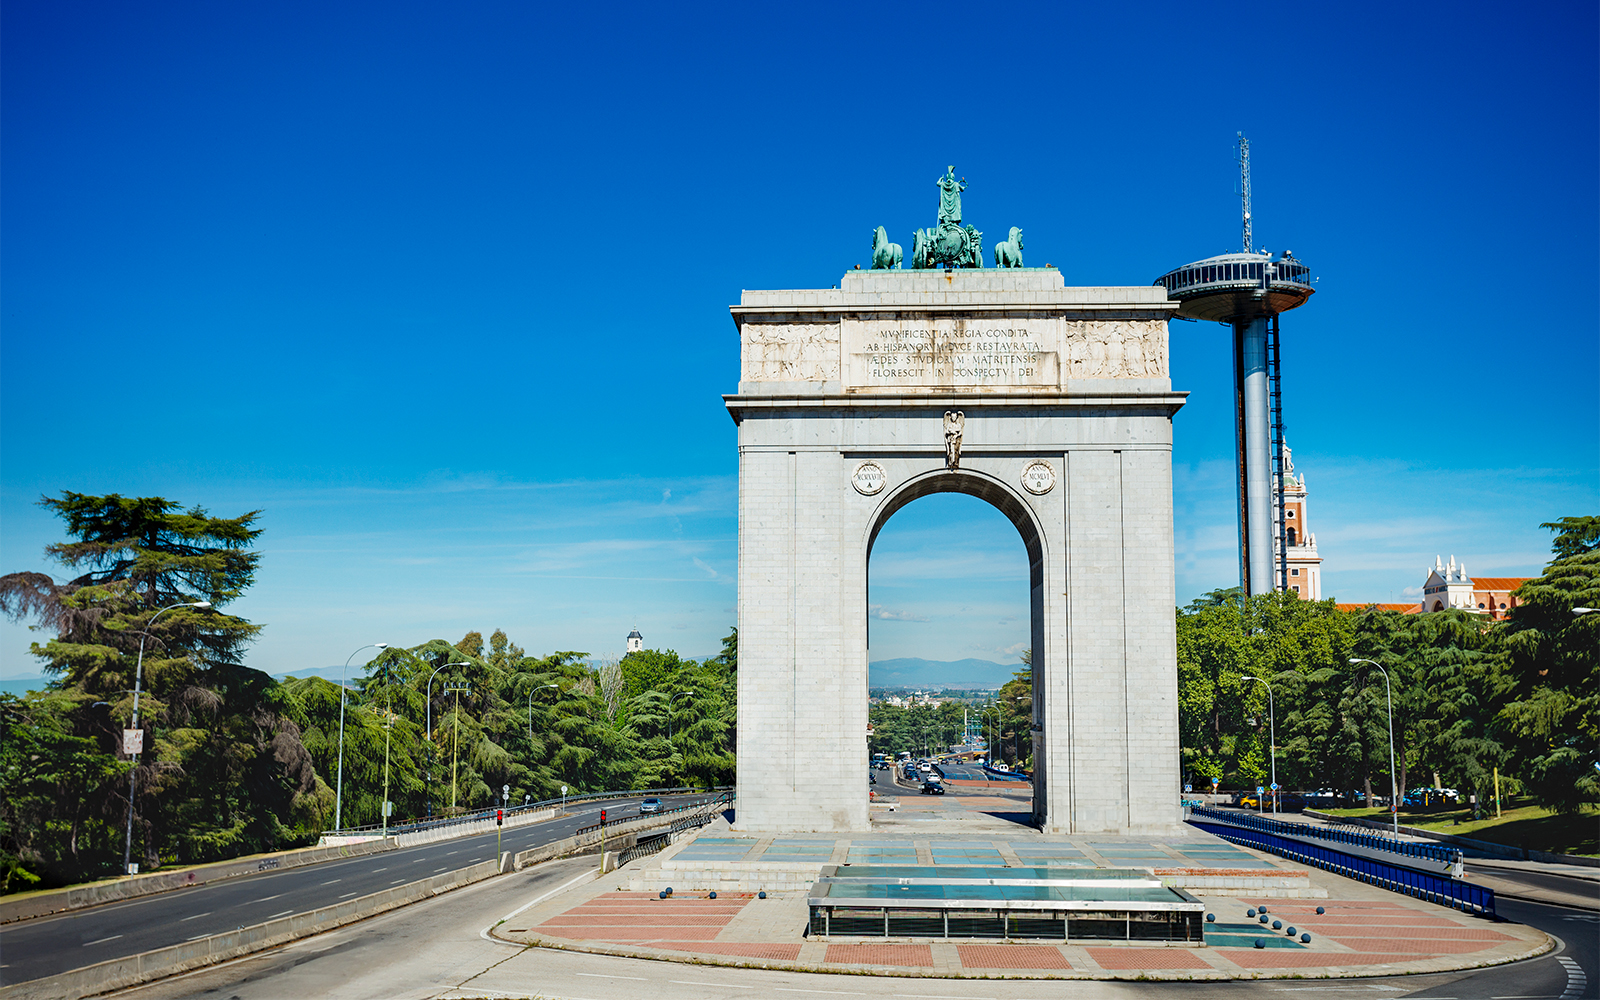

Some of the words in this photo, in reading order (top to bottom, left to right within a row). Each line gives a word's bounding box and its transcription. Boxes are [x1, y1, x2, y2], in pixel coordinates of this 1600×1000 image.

[953, 329, 982, 338] REGIA
[986, 328, 1029, 338] CONDITA
[866, 342, 880, 352] AB
[883, 342, 944, 352] HISPANORVM
[948, 342, 972, 351] DVCE
[976, 341, 1040, 351] RESTAVRATA
[906, 355, 964, 365] STVDIORVM
[972, 354, 1037, 364] MATRITENSIS
[872, 368, 925, 378] FLORESCIT
[935, 368, 945, 377] IN
[952, 367, 1010, 377] CONSPECTV
[1018, 367, 1034, 377] DEI
